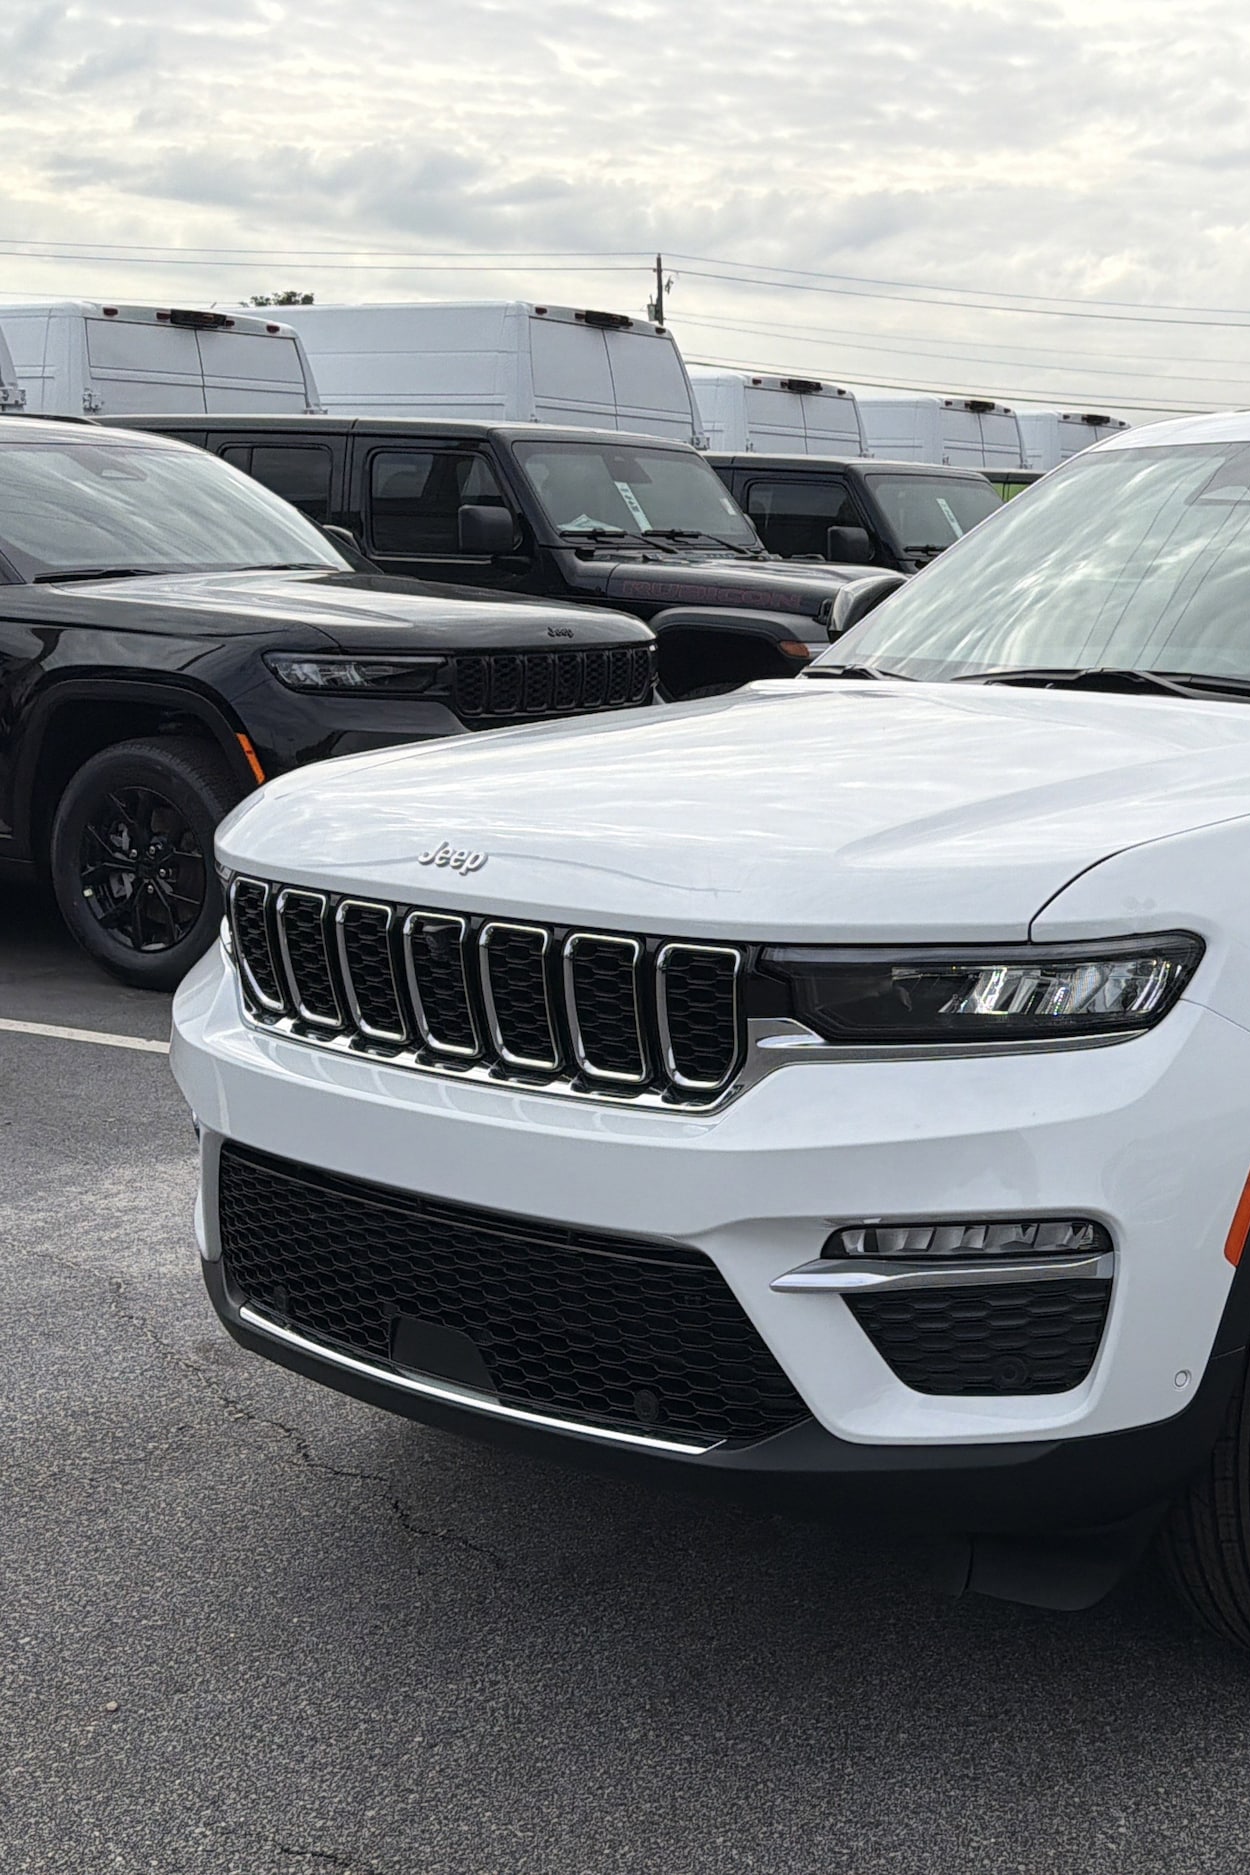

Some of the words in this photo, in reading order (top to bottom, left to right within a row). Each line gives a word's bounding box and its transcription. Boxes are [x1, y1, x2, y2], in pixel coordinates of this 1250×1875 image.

[623, 580, 801, 608] RUBICON
[547, 626, 574, 639] Jeep
[418, 840, 488, 876] Jeep
